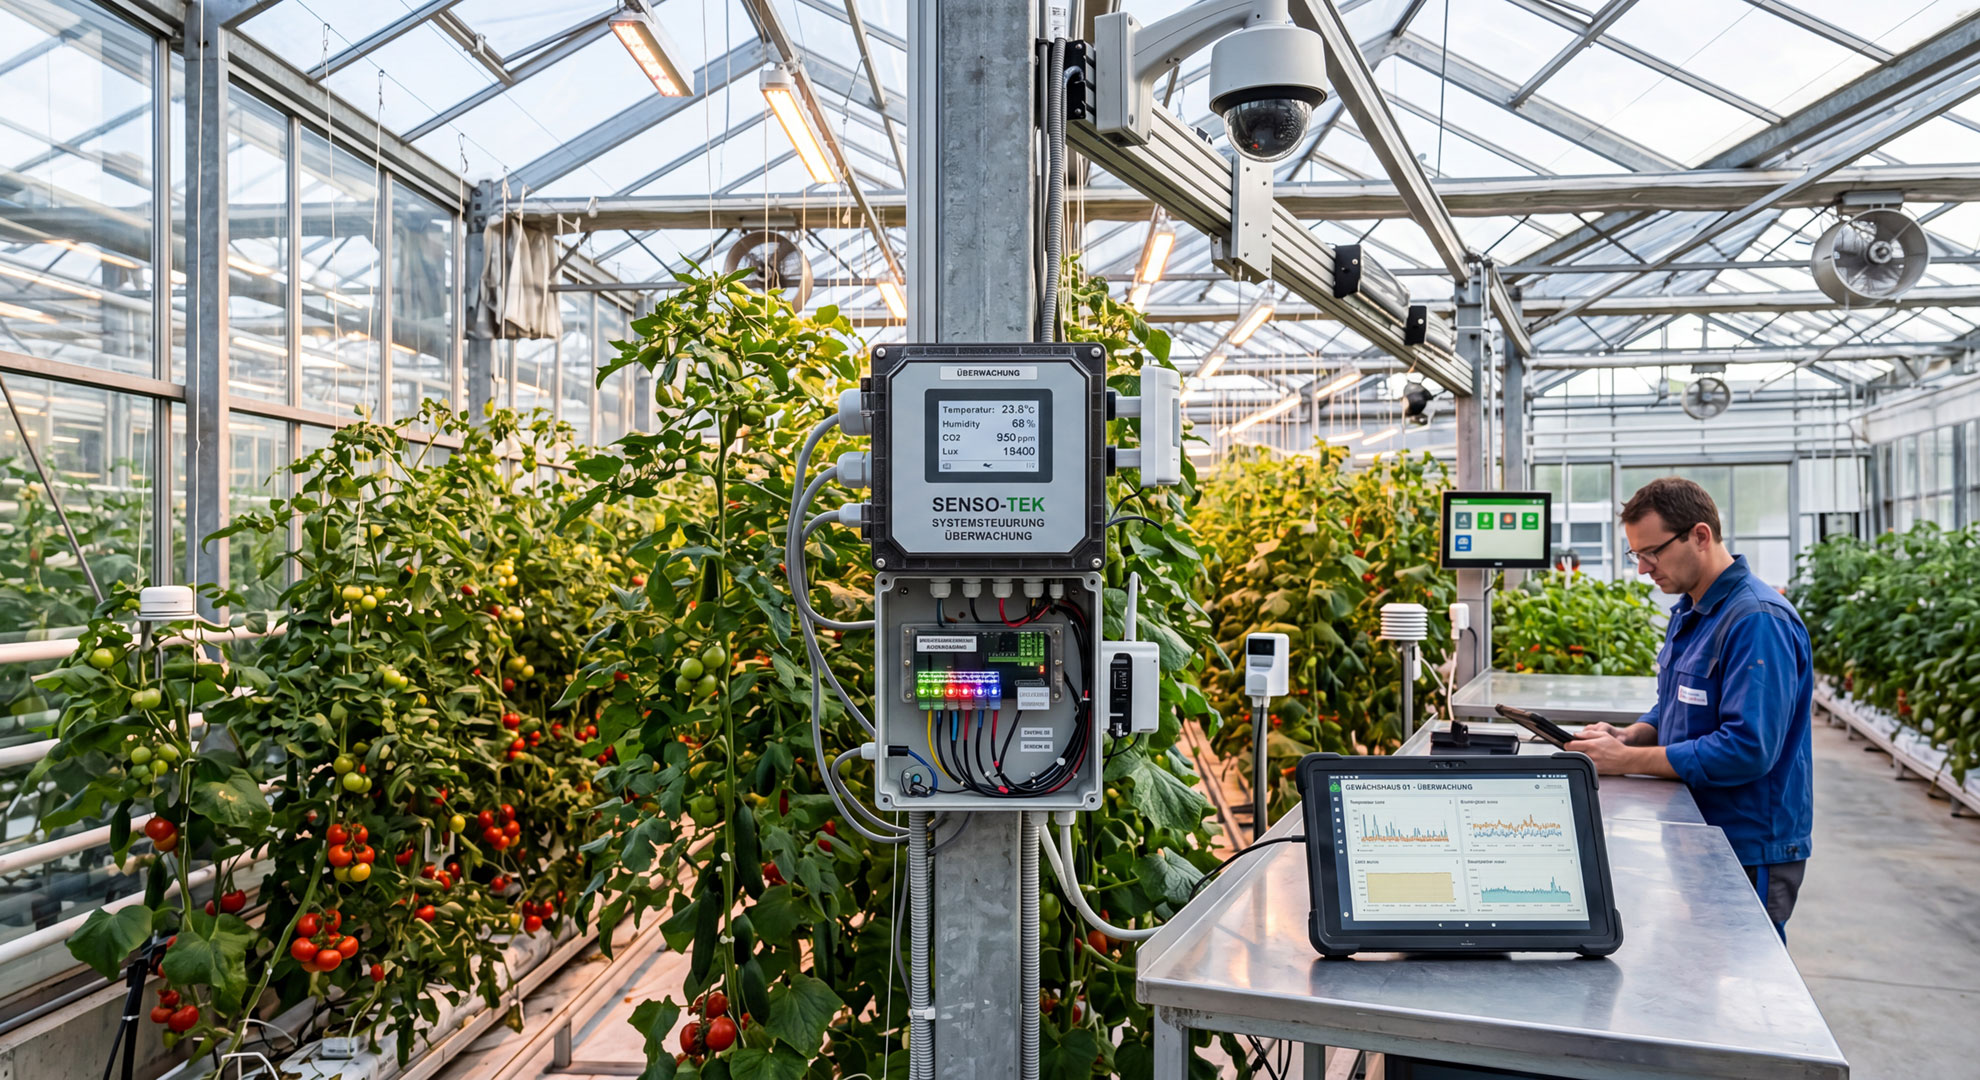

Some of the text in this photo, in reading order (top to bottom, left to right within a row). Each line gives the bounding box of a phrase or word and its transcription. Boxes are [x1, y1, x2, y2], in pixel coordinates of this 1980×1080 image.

[956, 368, 1020, 377] ÜBERWACHUNG
[1002, 405, 1035, 414] 23.8°C
[942, 420, 980, 429] Humidity
[1012, 419, 1025, 428] 68
[942, 434, 961, 442] CO2
[996, 433, 1016, 442] 950
[932, 497, 1046, 512] SENSO-TEK
[932, 518, 1045, 528] SYSTEMSTEUURUNG
[945, 530, 1033, 541] ÜBERWACHUNG
